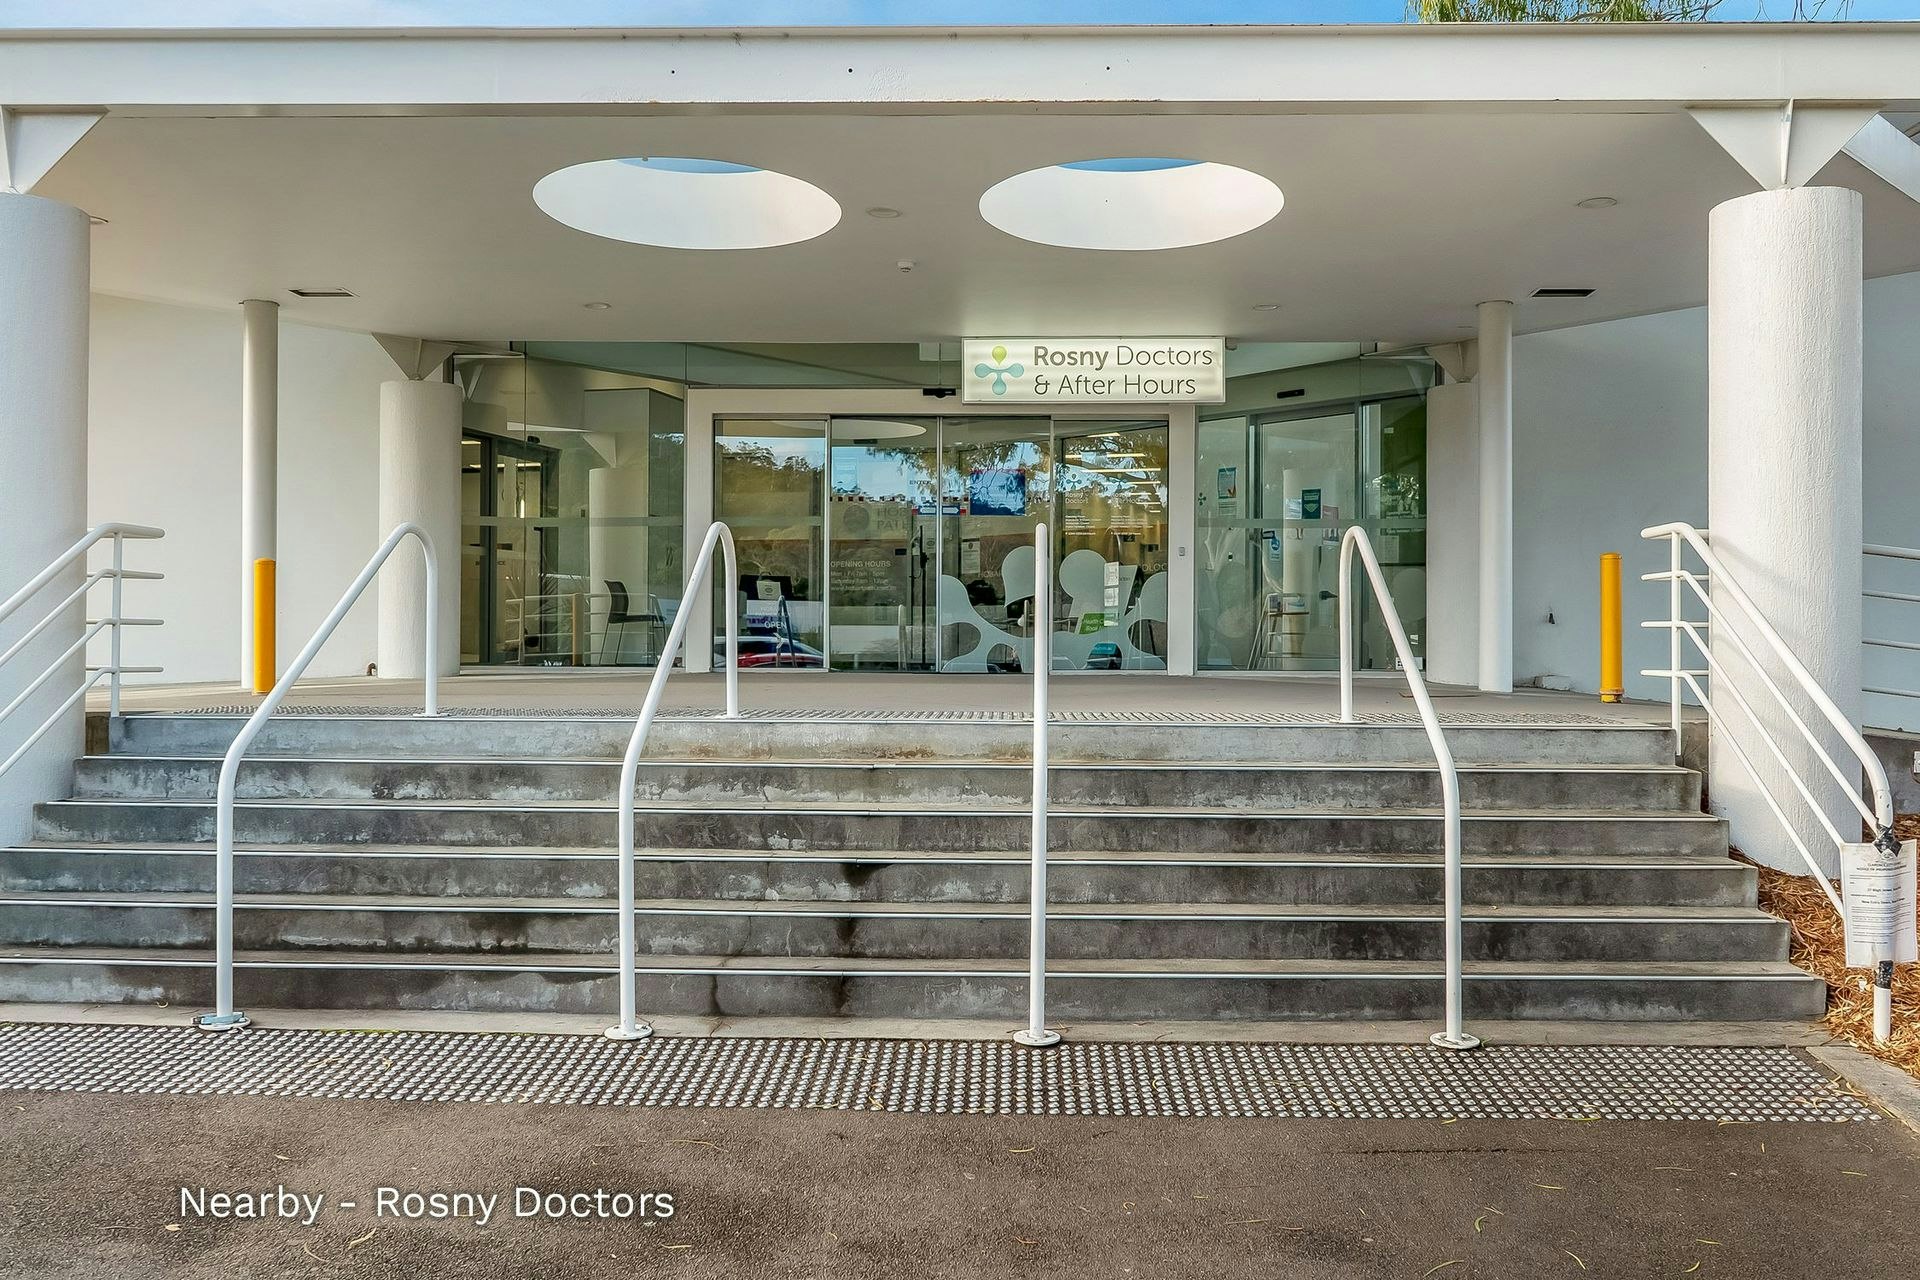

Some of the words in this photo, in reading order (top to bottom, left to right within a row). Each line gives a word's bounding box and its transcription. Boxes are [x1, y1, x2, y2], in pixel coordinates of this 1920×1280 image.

[1034, 346, 1109, 371] Rosny
[1117, 346, 1213, 366] Doctors
[1034, 374, 1051, 395] &
[1057, 374, 1116, 395] After
[1124, 374, 1196, 395] Hours
[830, 560, 863, 568] OPENING
[865, 560, 891, 568] HOURS
[764, 621, 787, 629] OPEN
